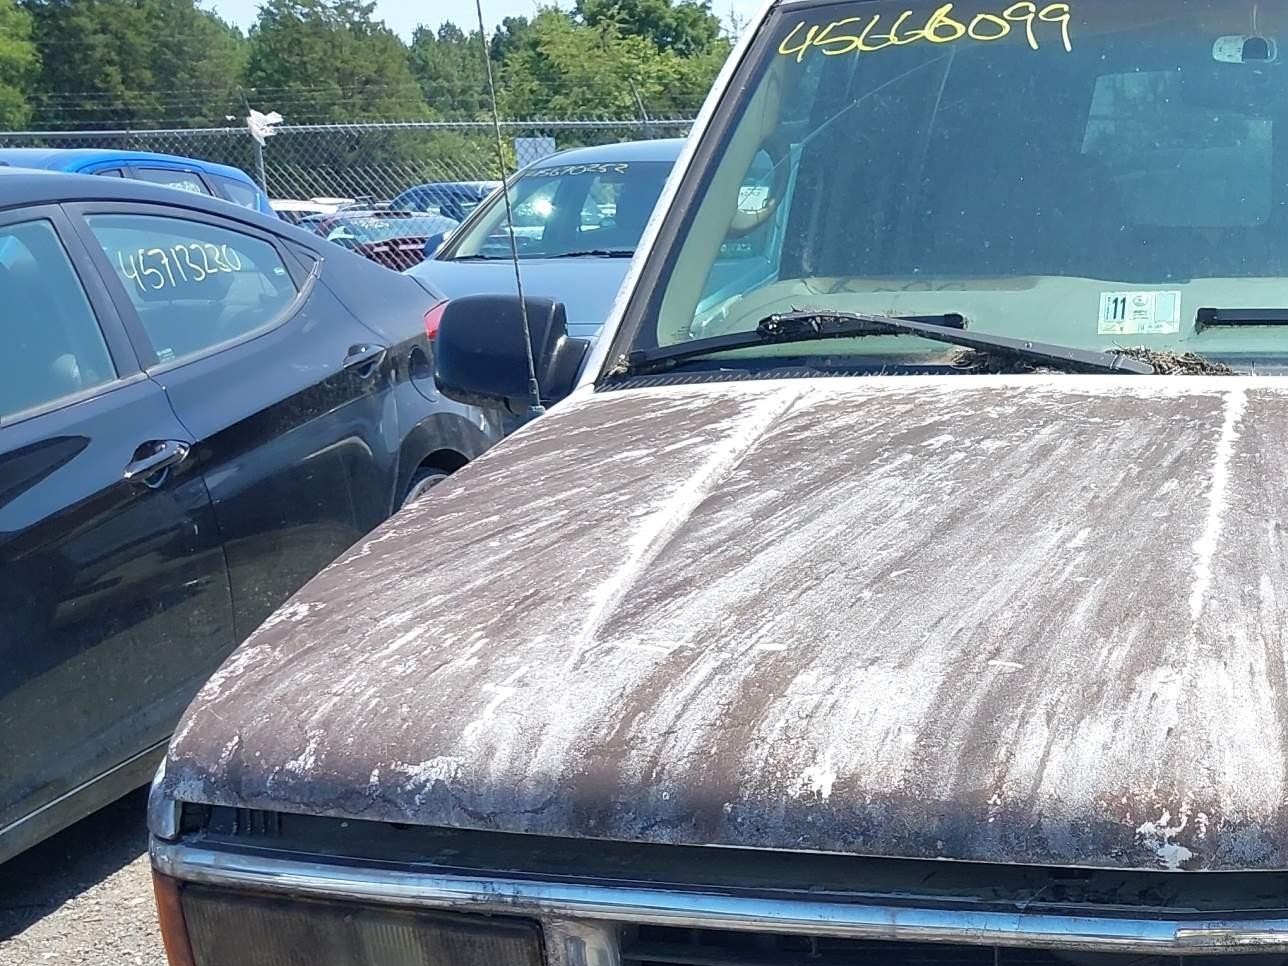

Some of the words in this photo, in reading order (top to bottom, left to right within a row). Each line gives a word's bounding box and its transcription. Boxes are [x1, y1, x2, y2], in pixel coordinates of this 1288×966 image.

[778, 2, 1072, 62] 45666099
[118, 243, 242, 291] 45713230
[1112, 296, 1127, 320] 11
